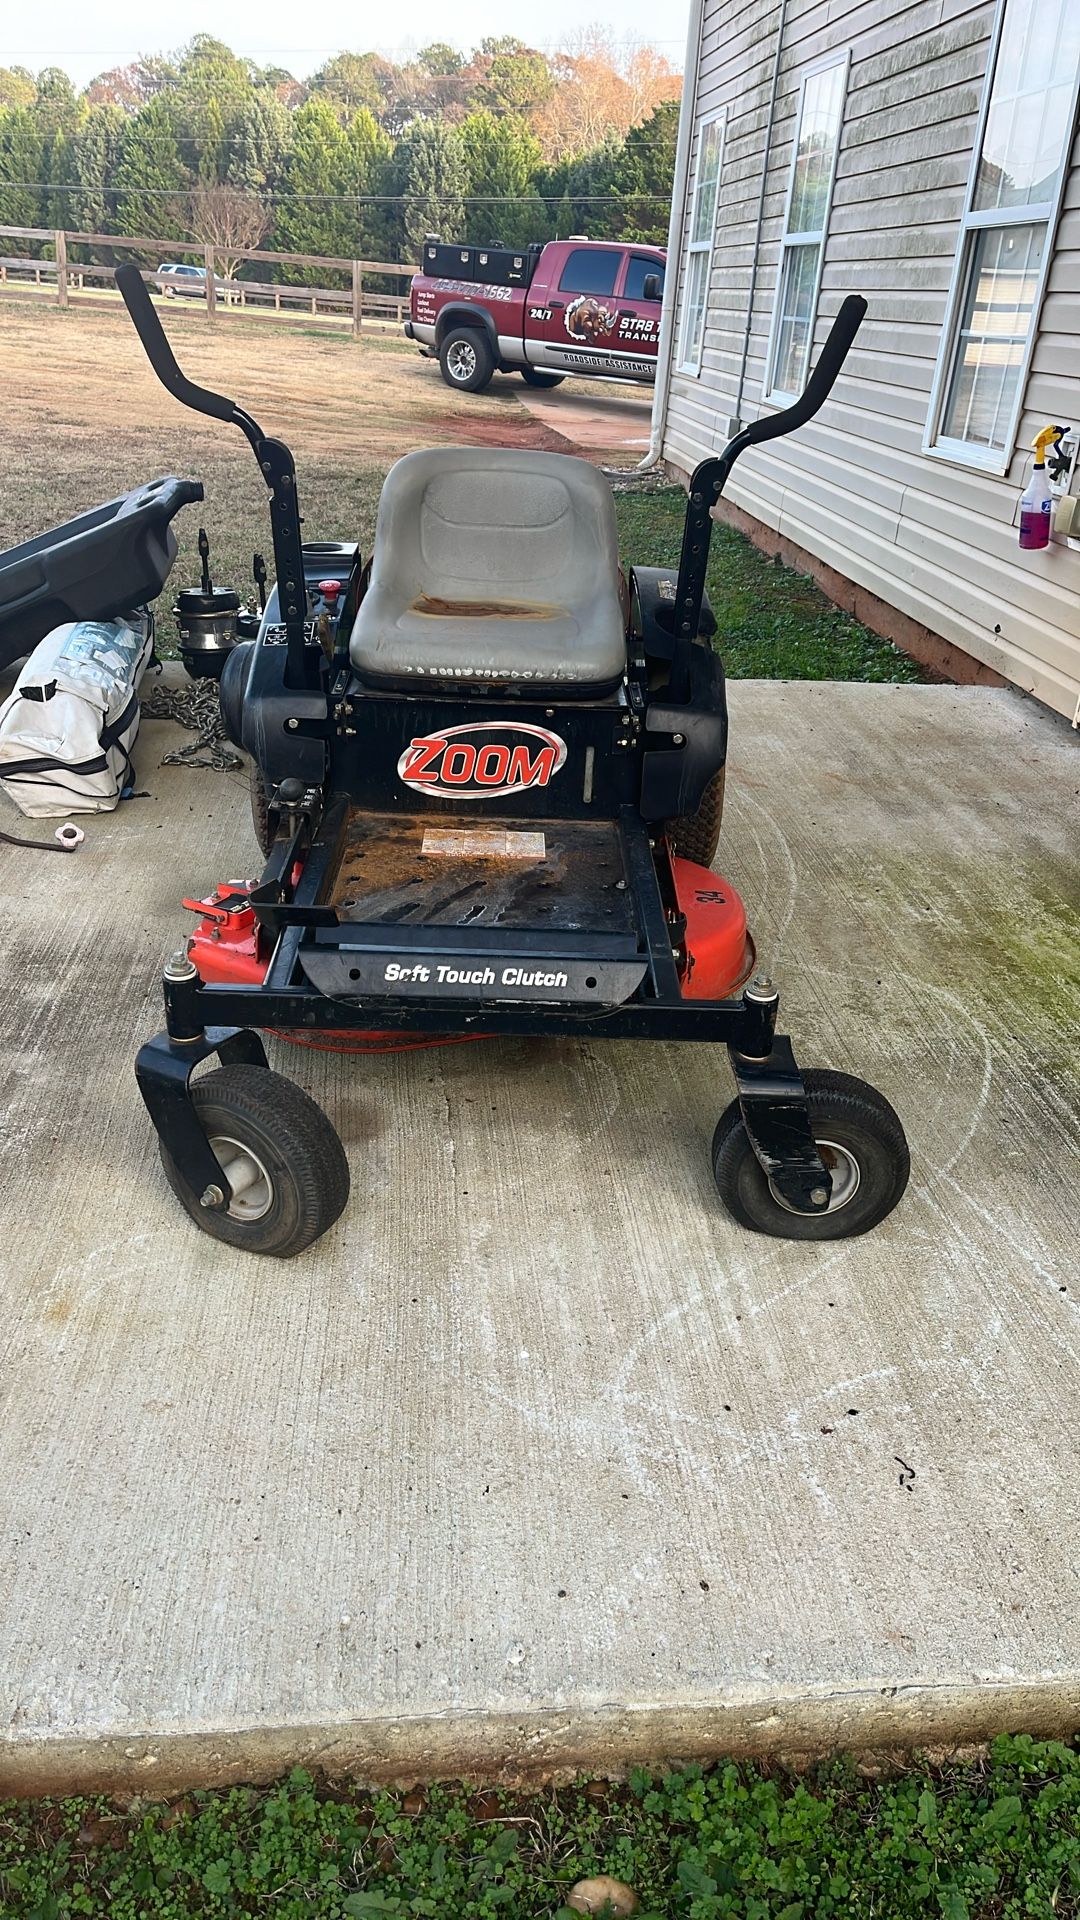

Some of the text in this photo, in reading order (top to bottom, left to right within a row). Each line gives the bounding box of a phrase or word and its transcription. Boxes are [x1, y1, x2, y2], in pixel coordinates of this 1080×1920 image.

[530, 309, 552, 320] 24/7
[619, 317, 655, 331] STR8
[563, 353, 653, 373] ROADSIDE ASSISTANCE
[402, 738, 555, 786] ZOOM
[384, 963, 568, 987] Soft Touch Clutch
